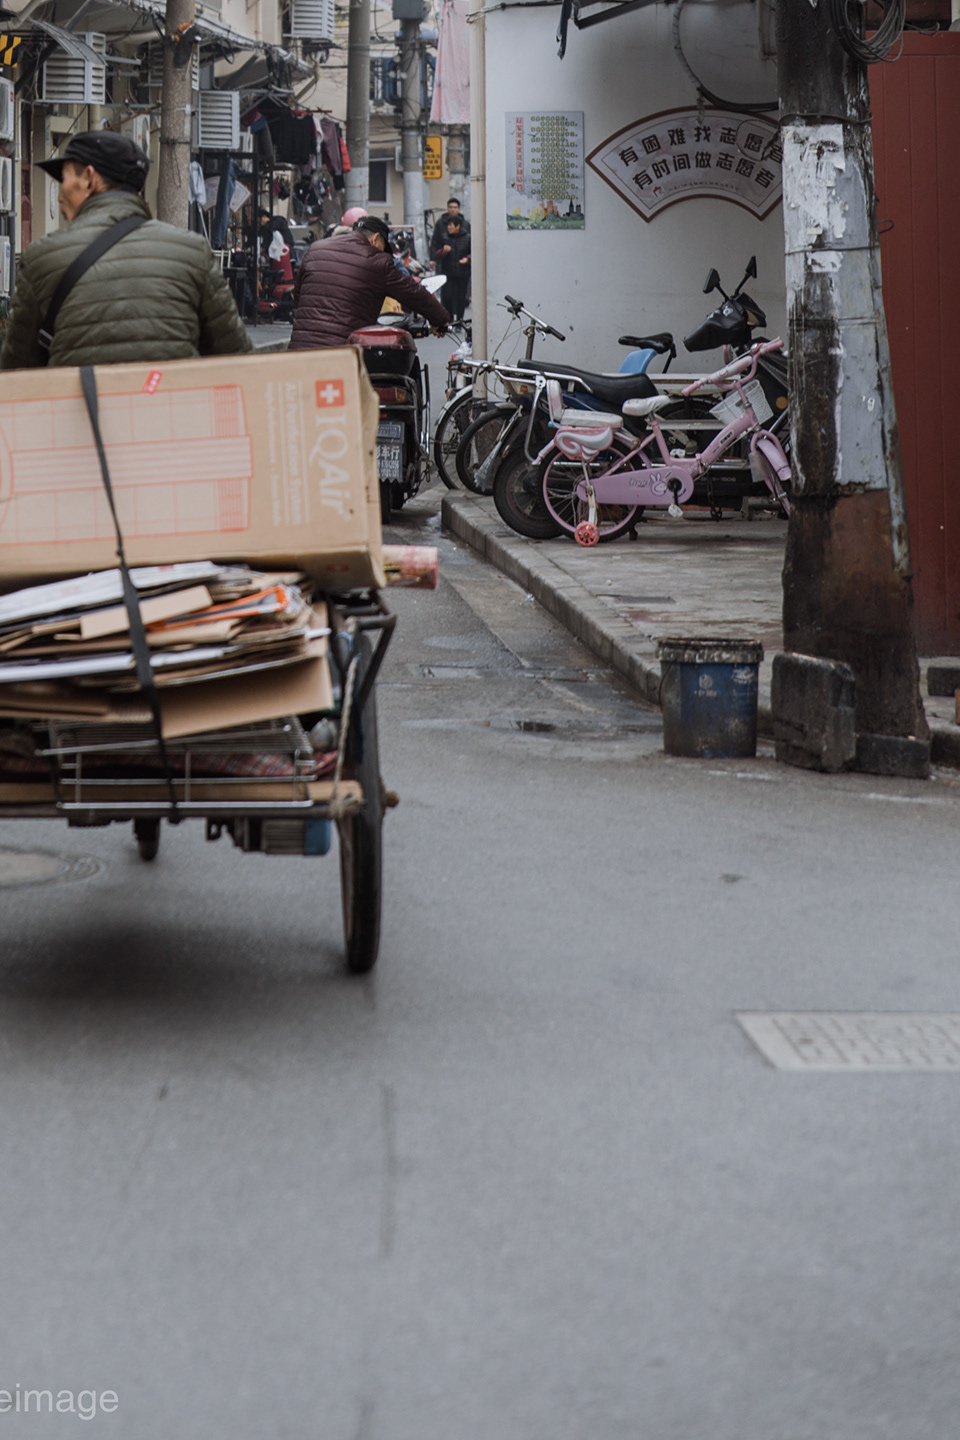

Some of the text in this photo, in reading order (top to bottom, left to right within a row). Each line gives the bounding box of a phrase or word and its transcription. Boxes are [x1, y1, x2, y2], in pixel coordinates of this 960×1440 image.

[618, 126, 784, 166] 有困难找志愿者
[632, 152, 776, 190] 有时间做志愿者
[308, 413, 352, 517] IQAir
